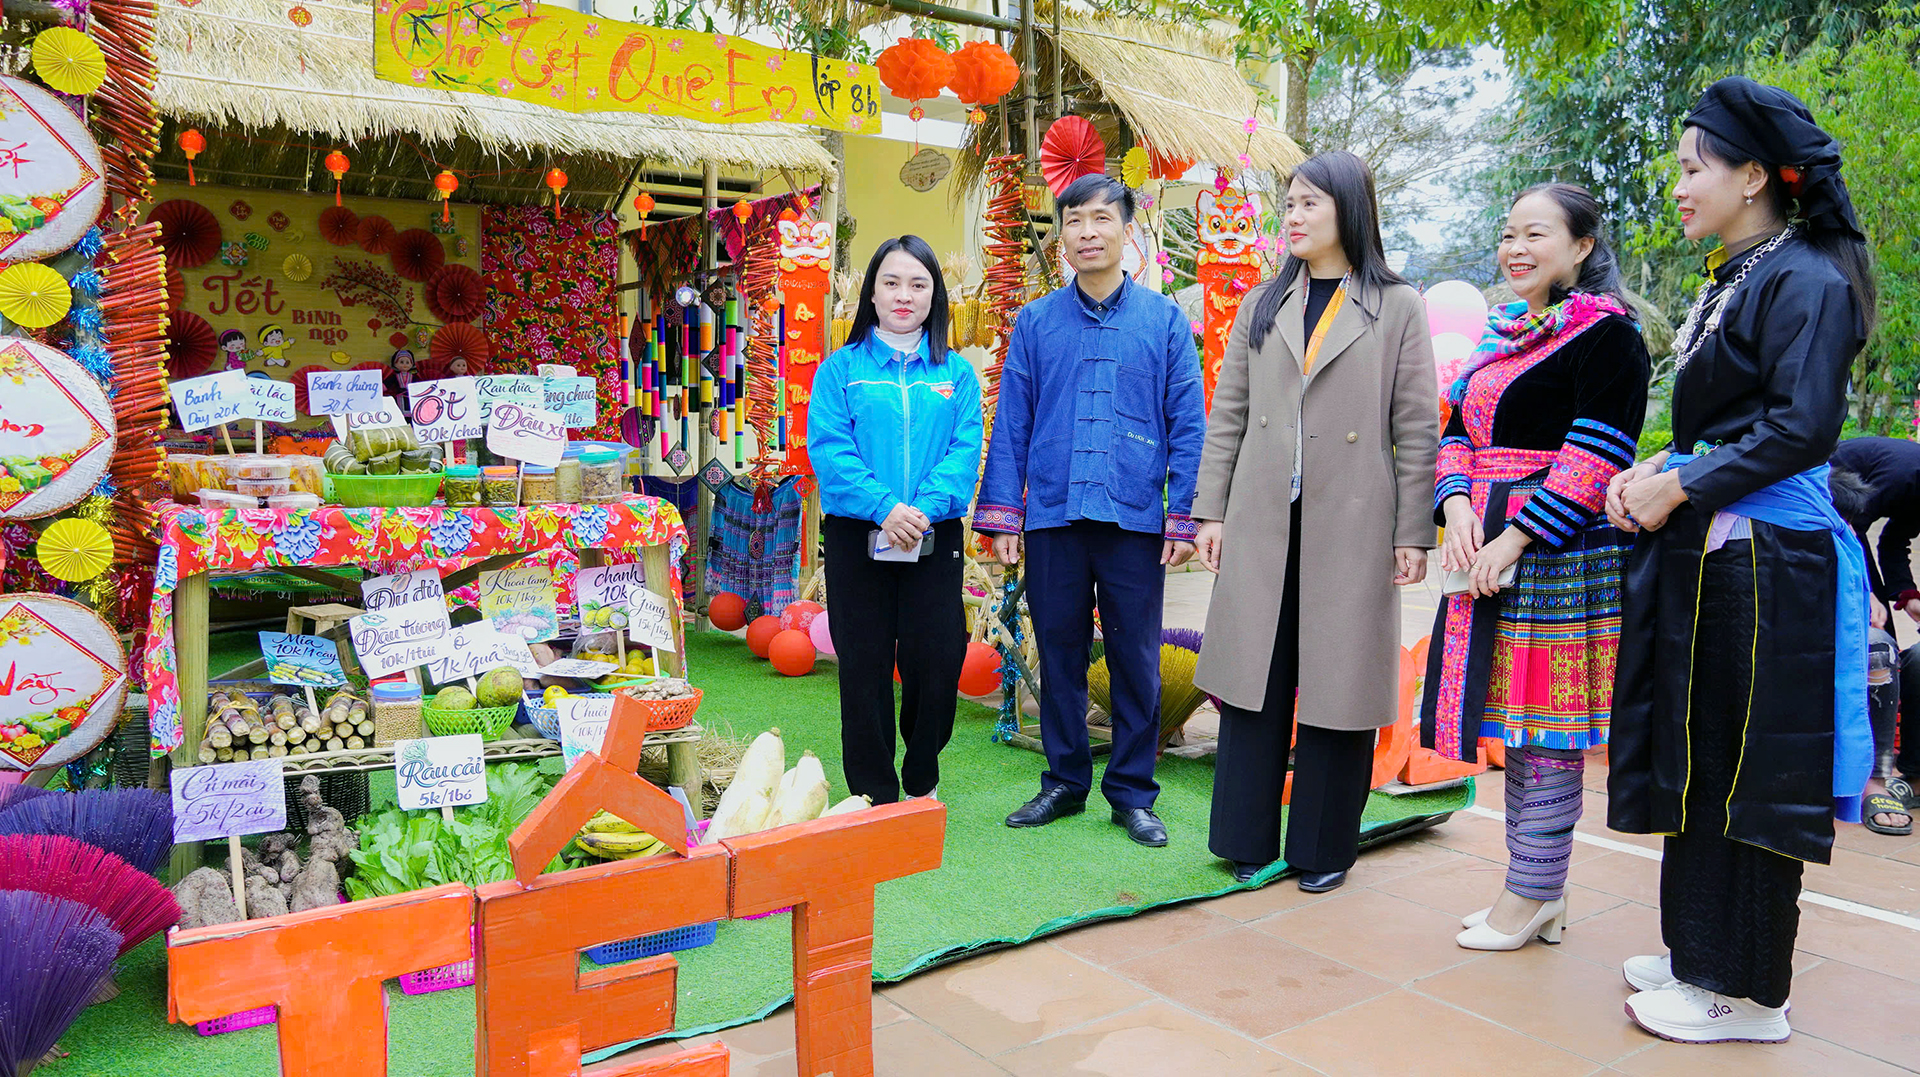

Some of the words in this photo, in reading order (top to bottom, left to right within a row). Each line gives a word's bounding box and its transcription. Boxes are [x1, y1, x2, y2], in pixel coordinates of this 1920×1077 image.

[506, 15, 597, 113] Tết
[608, 32, 714, 112] Quê
[203, 270, 285, 316] Tết
[184, 381, 222, 406] Bánh
[311, 373, 342, 392] Bánh
[475, 376, 506, 398] Rau
[418, 423, 483, 444] 30k/chai
[480, 569, 525, 596] Khoai
[527, 574, 552, 593] lang
[594, 564, 645, 588] chanh
[495, 591, 543, 609] 10k/1kg
[599, 584, 628, 603] 10k
[629, 588, 670, 623] Gừng
[638, 617, 673, 645] 15k/1kg
[570, 698, 609, 721] Chuối
[418, 788, 472, 807] 5k/1bó
